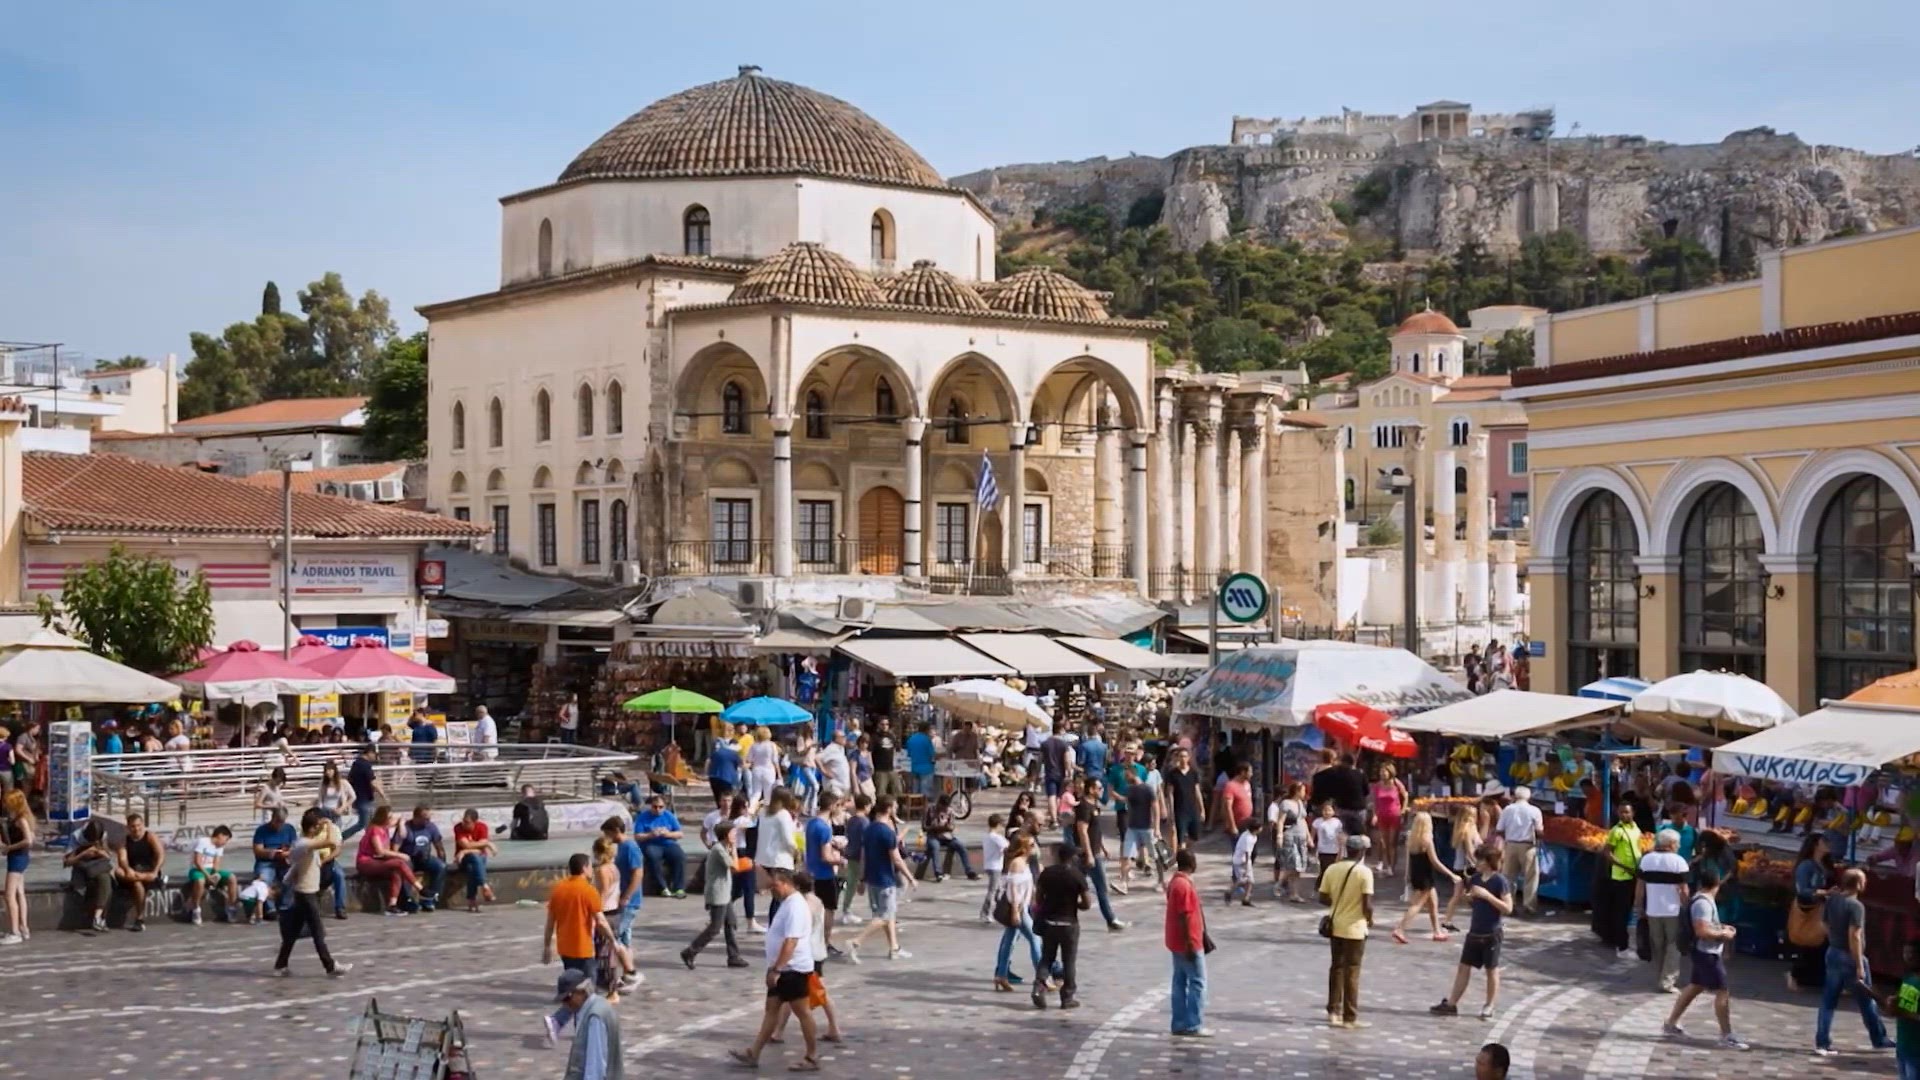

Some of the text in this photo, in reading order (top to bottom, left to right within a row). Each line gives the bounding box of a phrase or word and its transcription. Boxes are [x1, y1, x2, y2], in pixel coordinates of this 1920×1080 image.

[302, 566, 395, 577] ADRIANOS TRAVEL
[327, 633, 348, 646] Star
